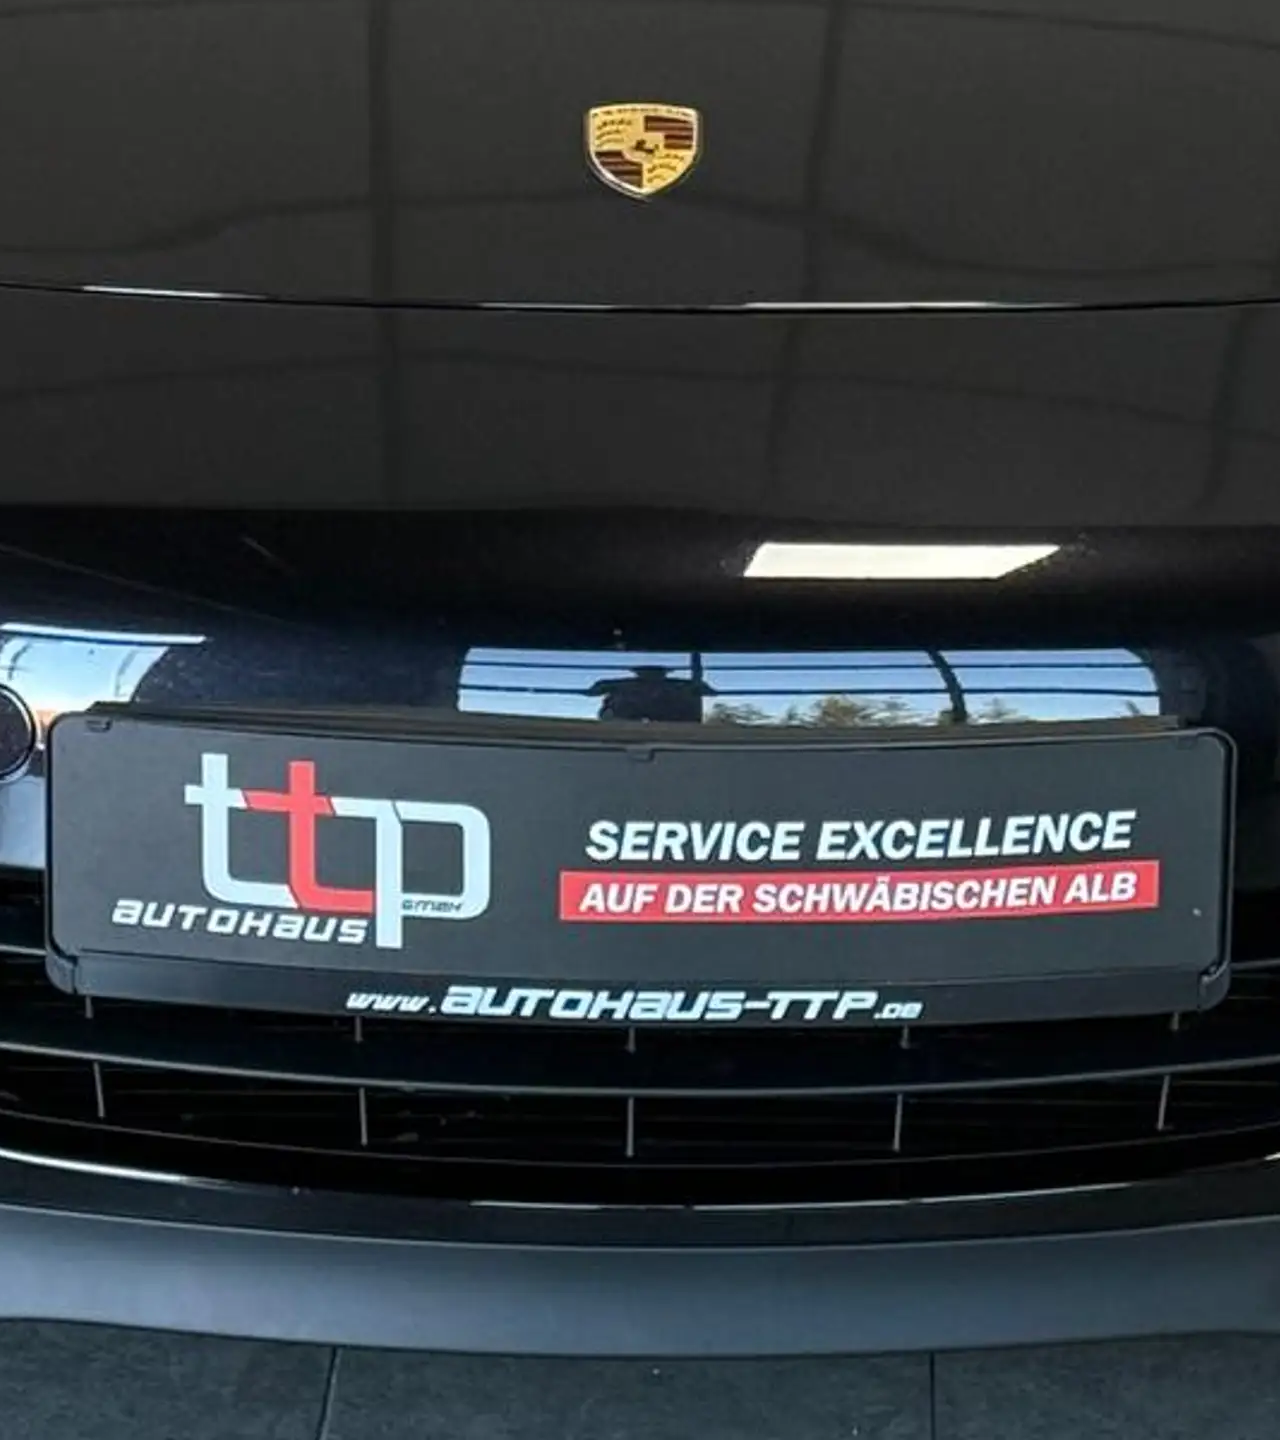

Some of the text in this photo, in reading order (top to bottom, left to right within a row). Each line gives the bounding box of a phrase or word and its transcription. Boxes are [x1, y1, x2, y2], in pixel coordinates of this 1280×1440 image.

[585, 809, 1137, 861] SERVICE EXCELLENCE
[578, 871, 1137, 914] AUF DER SCHWÄBISCHEN ALB
